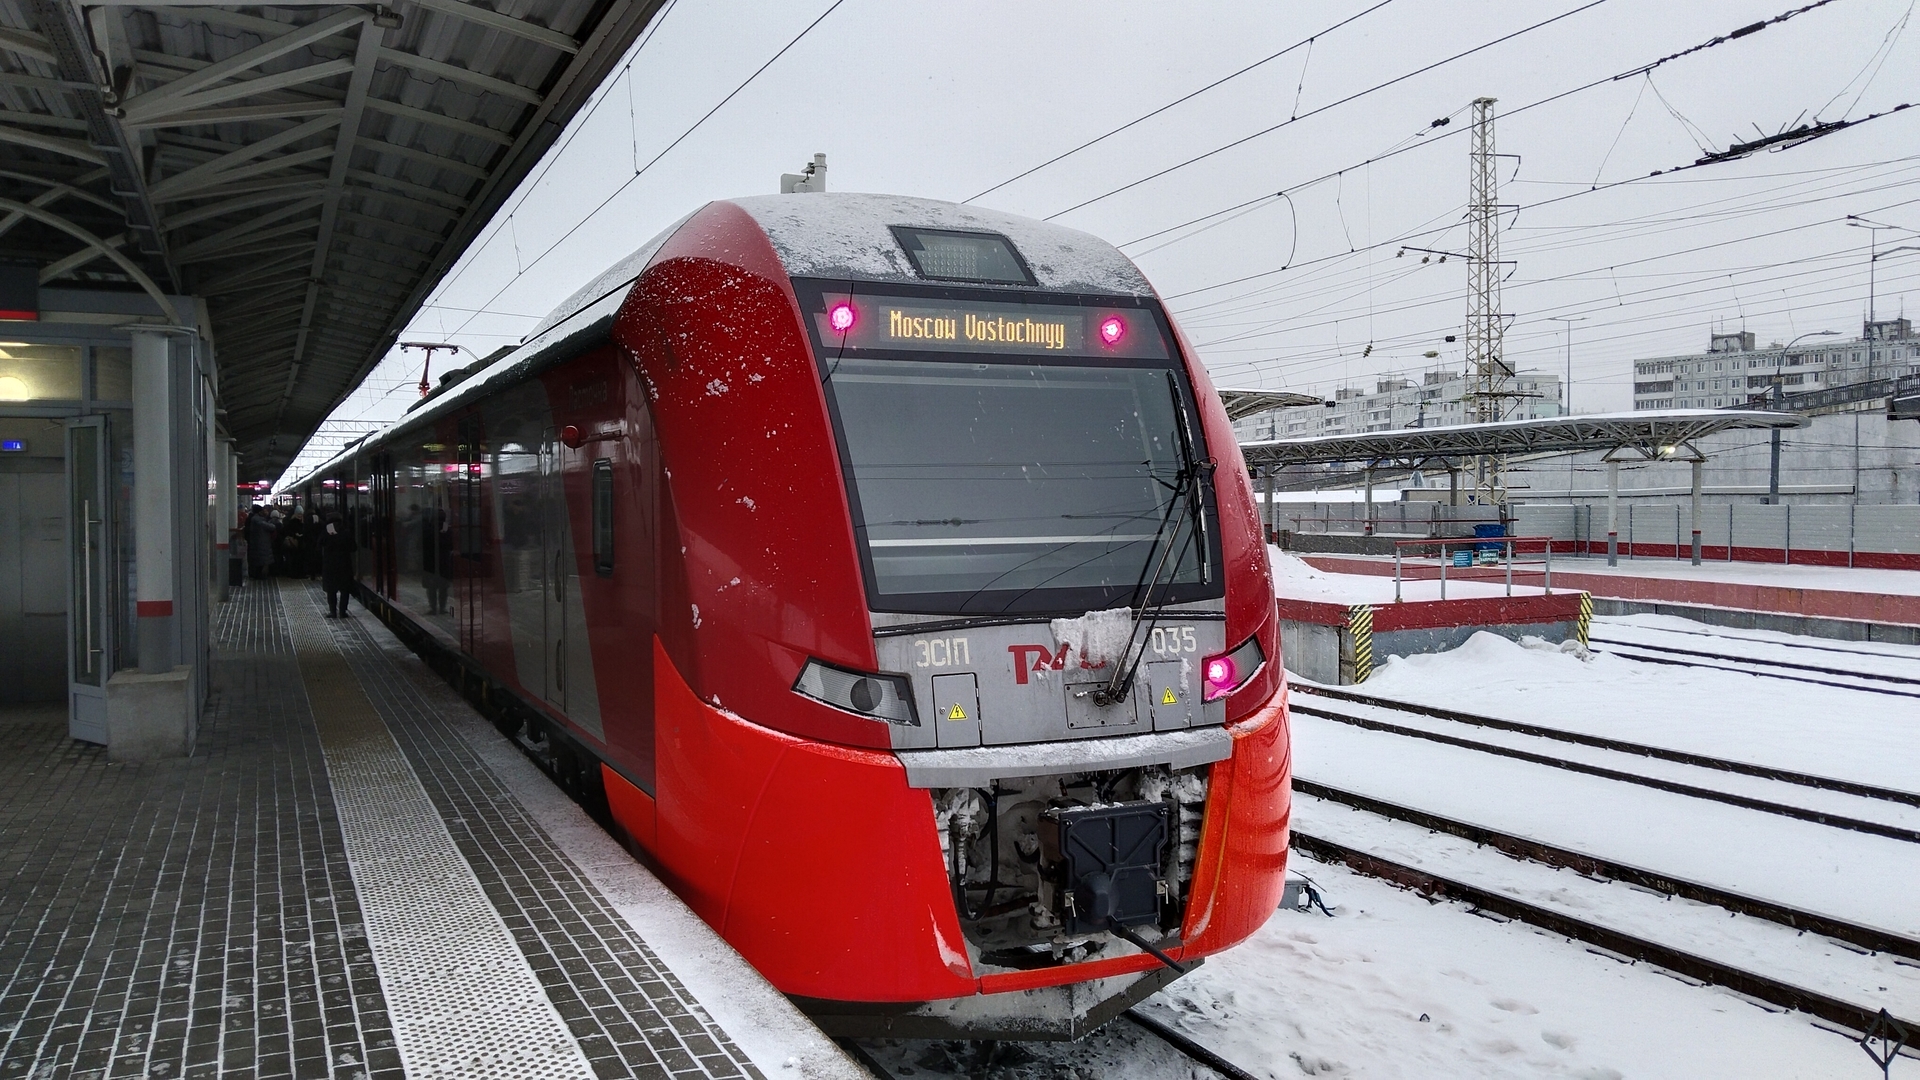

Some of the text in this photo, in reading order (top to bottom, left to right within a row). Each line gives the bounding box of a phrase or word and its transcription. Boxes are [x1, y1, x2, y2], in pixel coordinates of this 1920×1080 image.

[889, 309, 1066, 350] Moscow Vostochnyy
[1151, 626, 1197, 654] 035
